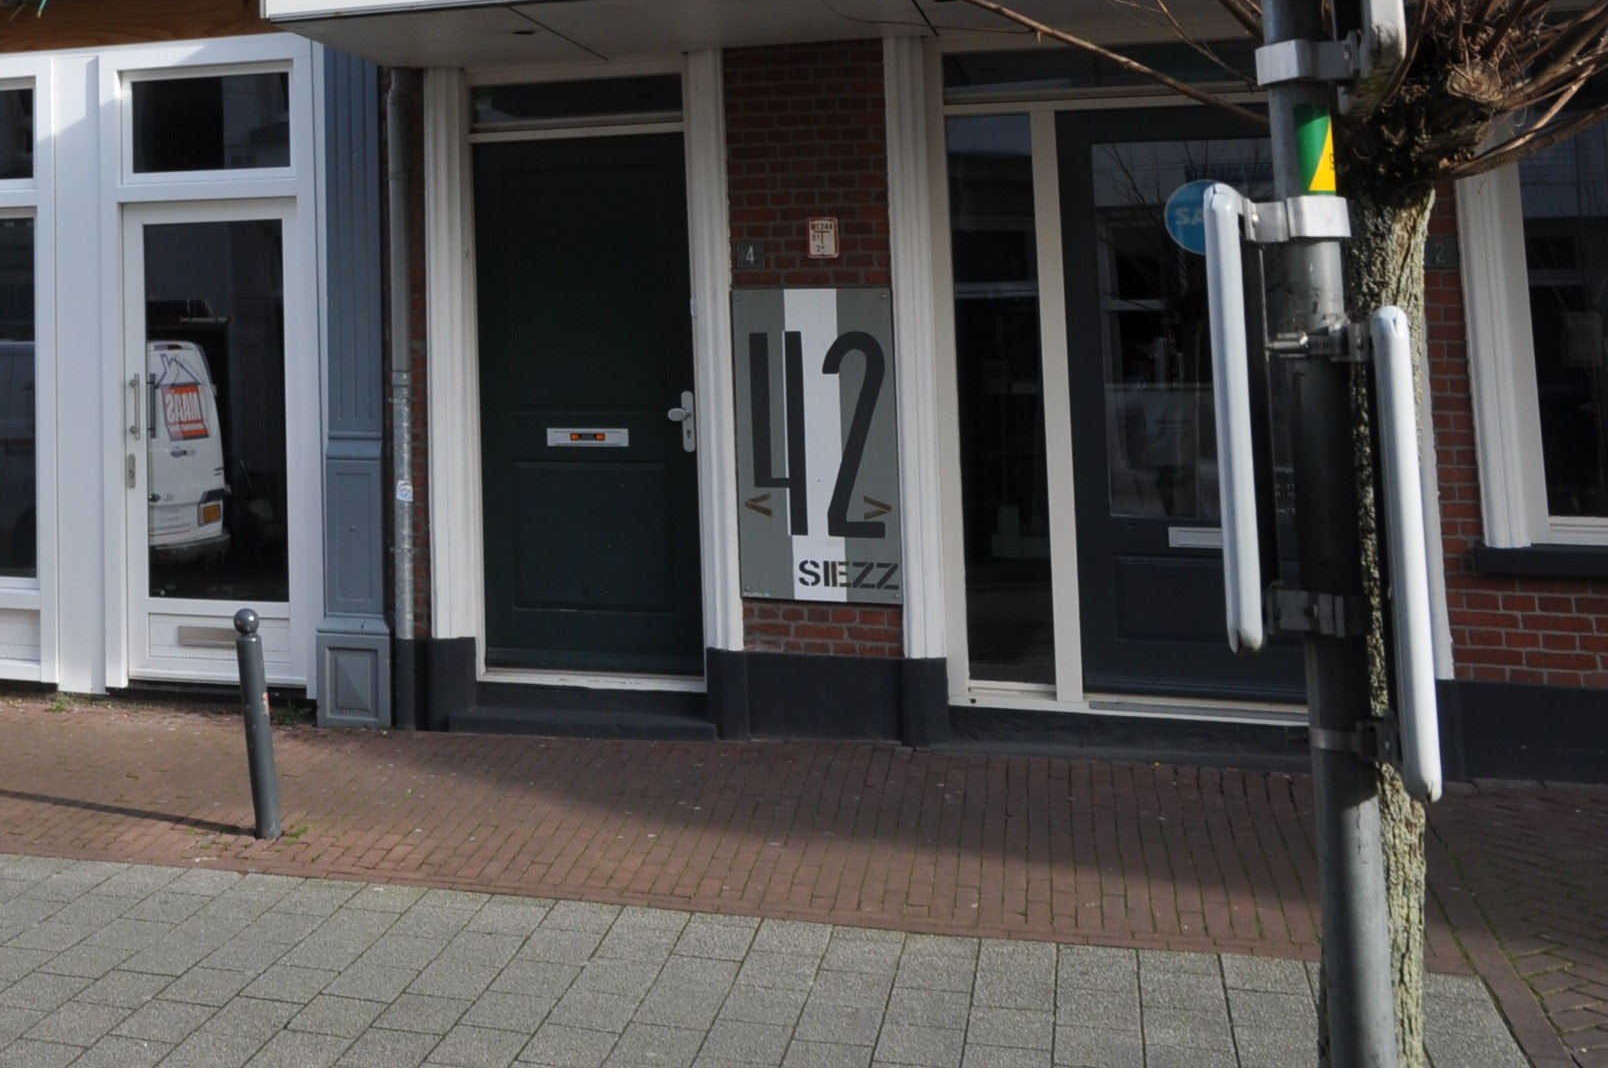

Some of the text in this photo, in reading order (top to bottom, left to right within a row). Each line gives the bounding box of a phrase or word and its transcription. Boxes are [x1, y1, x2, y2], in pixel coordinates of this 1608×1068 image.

[1175, 207, 1205, 225] SA
[745, 245, 756, 265] 4
[1434, 242, 1446, 263] 2
[749, 330, 886, 539] 42
[798, 560, 900, 591] SIEZZ
